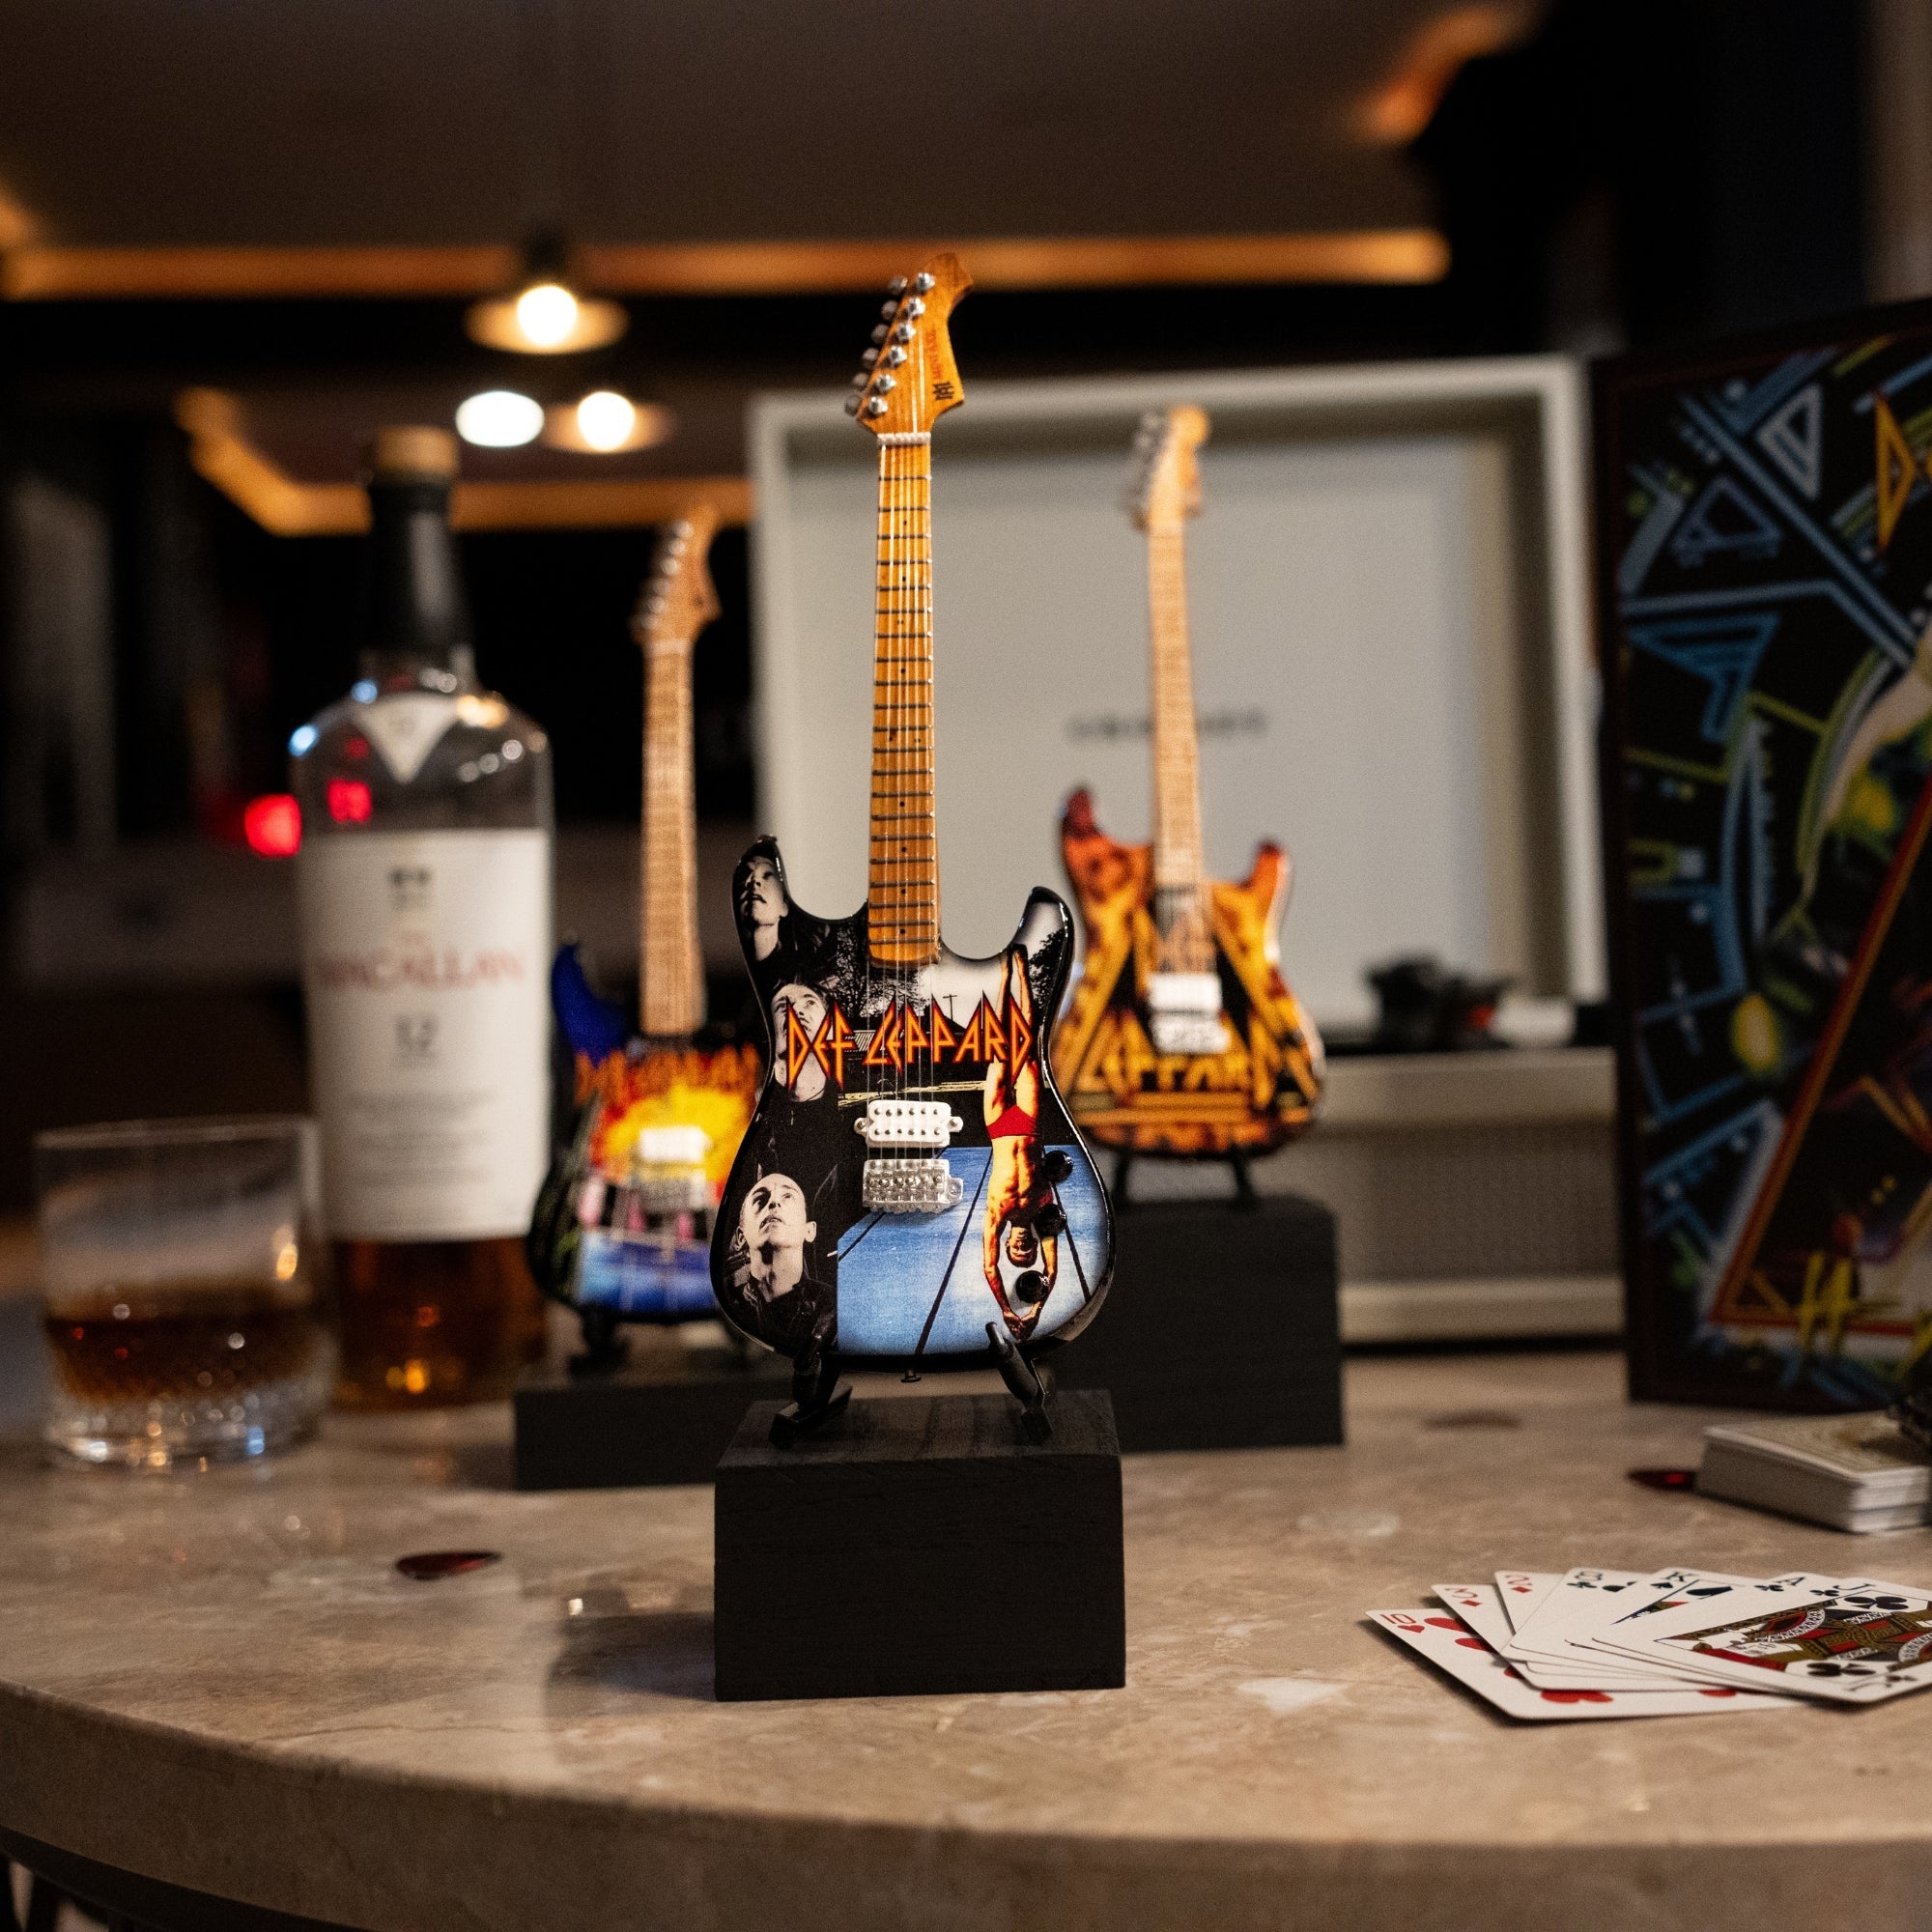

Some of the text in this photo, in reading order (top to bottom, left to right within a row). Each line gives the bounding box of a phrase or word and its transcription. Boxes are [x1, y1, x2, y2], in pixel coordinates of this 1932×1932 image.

[785, 994, 857, 1091] DEF
[863, 989, 1033, 1085] LEPPARD
[1661, 1572, 1699, 1582] K
[1775, 1577, 1805, 1586] A
[1379, 1613, 1416, 1624] 10
